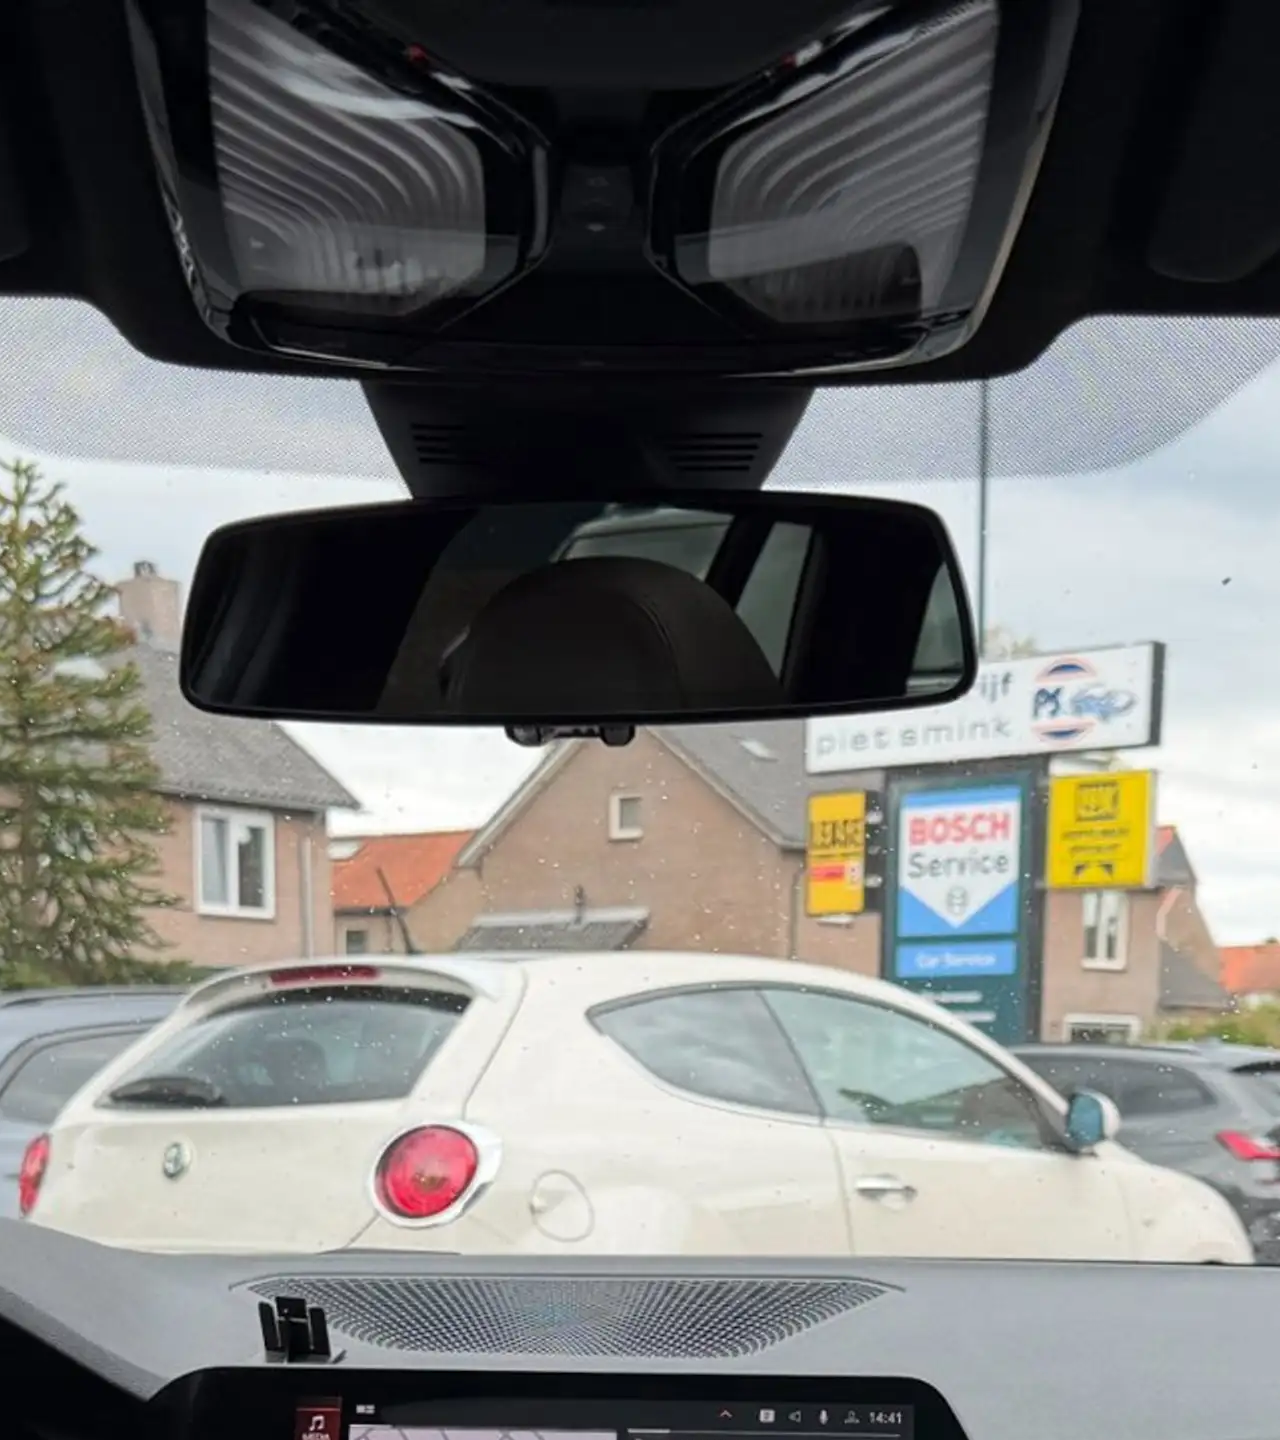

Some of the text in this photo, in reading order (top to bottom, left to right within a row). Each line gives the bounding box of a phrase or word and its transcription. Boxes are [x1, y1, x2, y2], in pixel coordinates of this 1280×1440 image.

[900, 716, 1012, 746] smink
[908, 811, 1011, 846] BOSCH
[907, 848, 1010, 879] Service
[869, 1412, 902, 1424] 14:41
